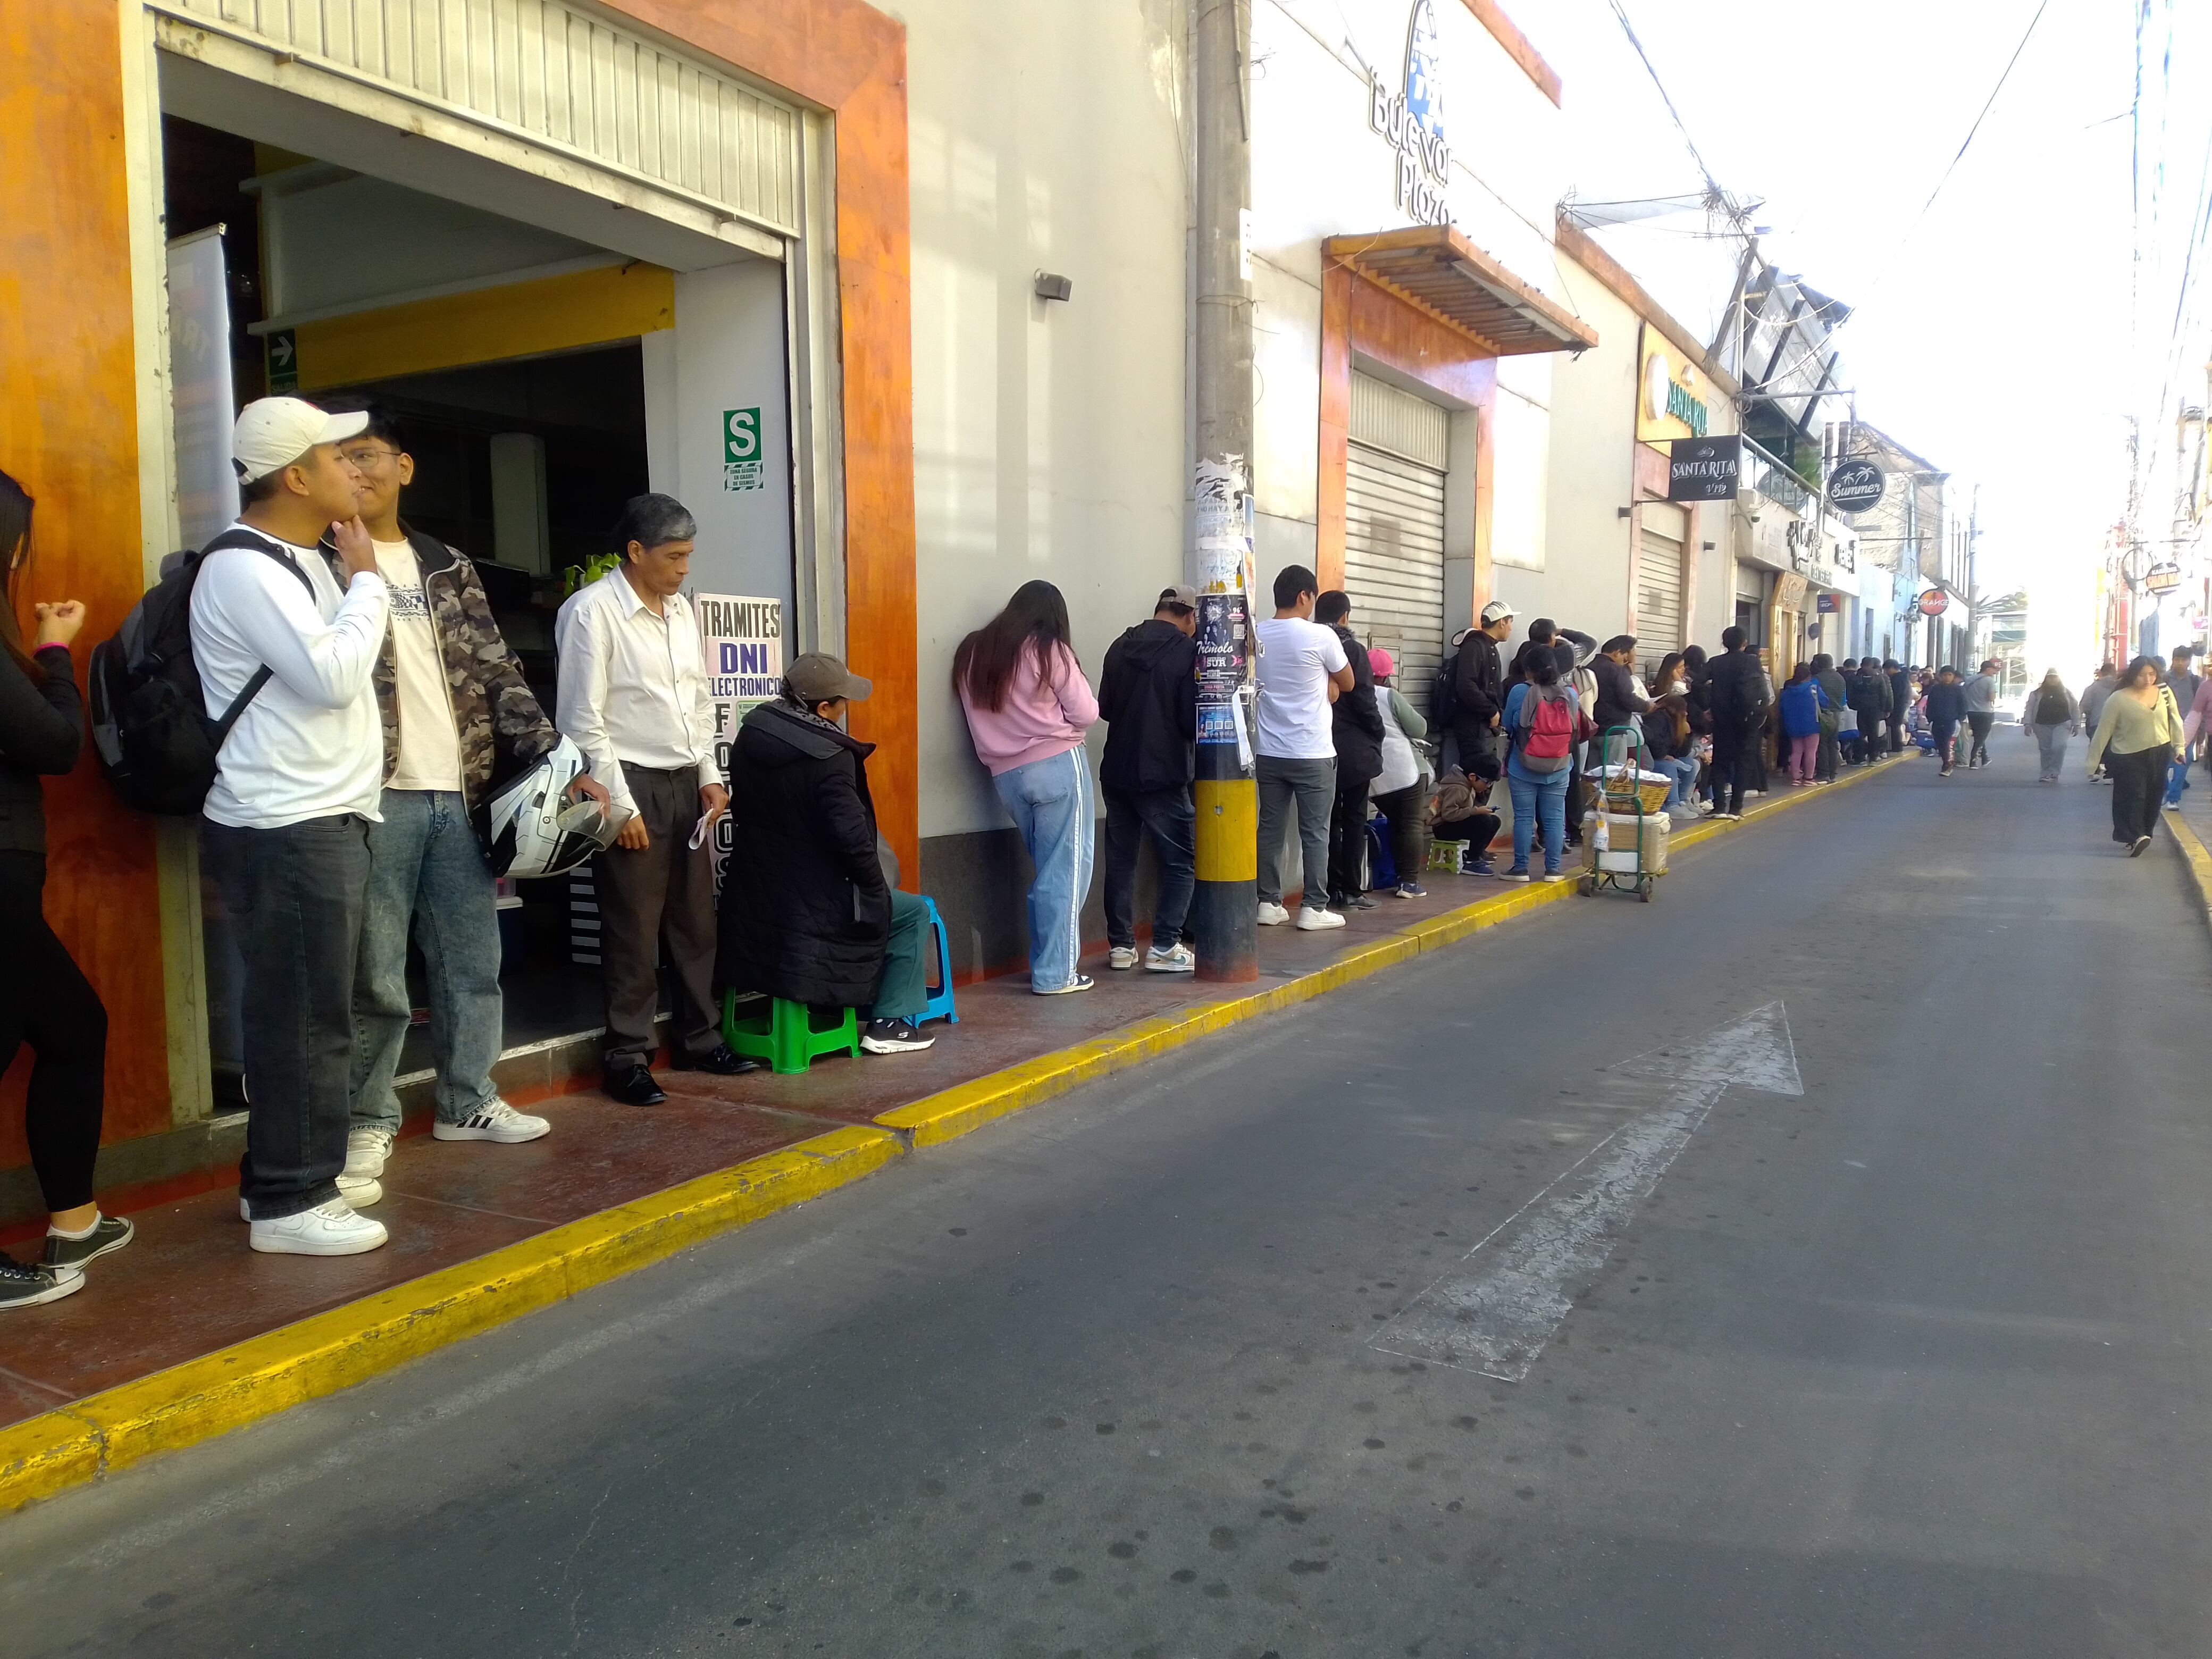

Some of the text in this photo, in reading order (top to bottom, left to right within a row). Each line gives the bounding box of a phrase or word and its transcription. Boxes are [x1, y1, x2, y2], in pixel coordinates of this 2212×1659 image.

[729, 412, 756, 457] S
[1671, 458, 1738, 481] SANTA RITA
[1830, 482, 1882, 498] Summer
[700, 600, 781, 638] TRAMITES
[719, 642, 768, 674] DNI
